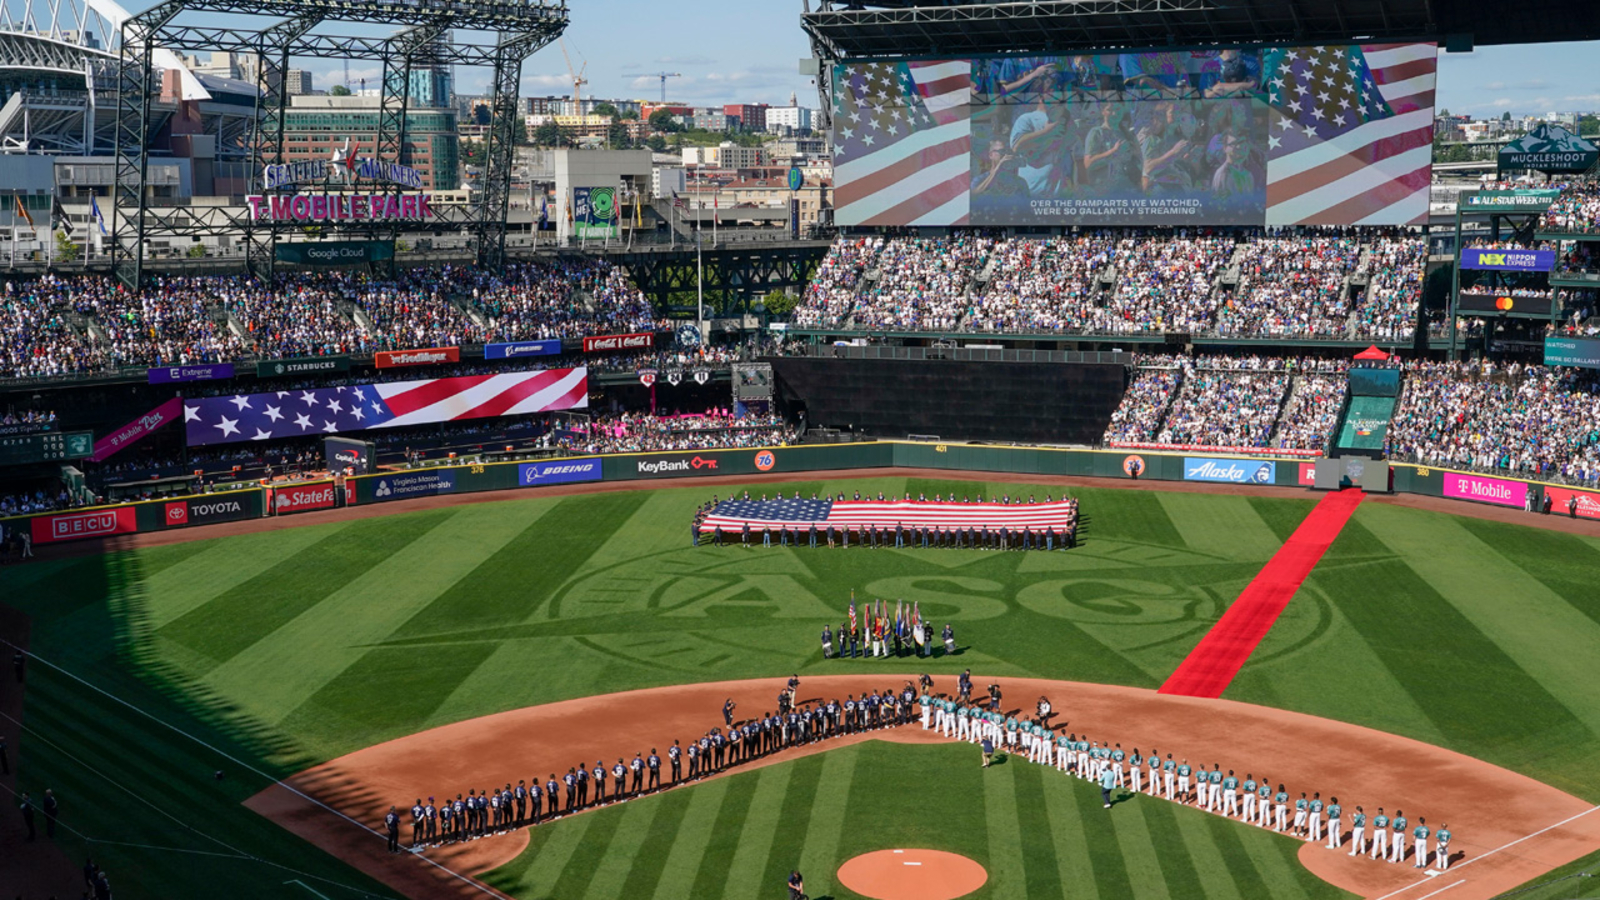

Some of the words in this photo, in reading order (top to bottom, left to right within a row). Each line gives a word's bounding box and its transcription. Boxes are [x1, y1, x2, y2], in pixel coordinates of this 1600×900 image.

[1510, 153, 1586, 163] MUCKLESHOOT
[266, 159, 327, 188] SEATTLE
[361, 157, 422, 188] MARINERS
[791, 169, 797, 188] P
[246, 195, 366, 220] T-MOBILE
[369, 194, 433, 219] PARK
[1131, 199, 1147, 207] WE
[1150, 199, 1202, 207] WATCHED,
[1034, 207, 1061, 215] WERE
[1064, 207, 1077, 215] SO
[1079, 207, 1134, 215] GALLANTLY
[1138, 207, 1196, 215] STREAMING
[307, 248, 339, 259] Google
[340, 248, 364, 257] Cloud
[287, 362, 336, 372] STARBUCKS
[670, 373, 680, 382] 24
[118, 426, 143, 443] Mobile
[936, 445, 947, 453] 401
[758, 455, 772, 465] 76
[471, 465, 484, 474] 376
[543, 464, 593, 475] BOEING
[638, 460, 689, 473] KeyBank
[1188, 461, 1245, 479] Alaska
[1417, 467, 1429, 477] 380
[393, 476, 418, 487] Virginia
[418, 475, 440, 484] Mason
[393, 484, 428, 494] Franciscan
[428, 481, 451, 489] Health
[1471, 481, 1511, 499] Mobile
[192, 501, 241, 516] TOYOTA
